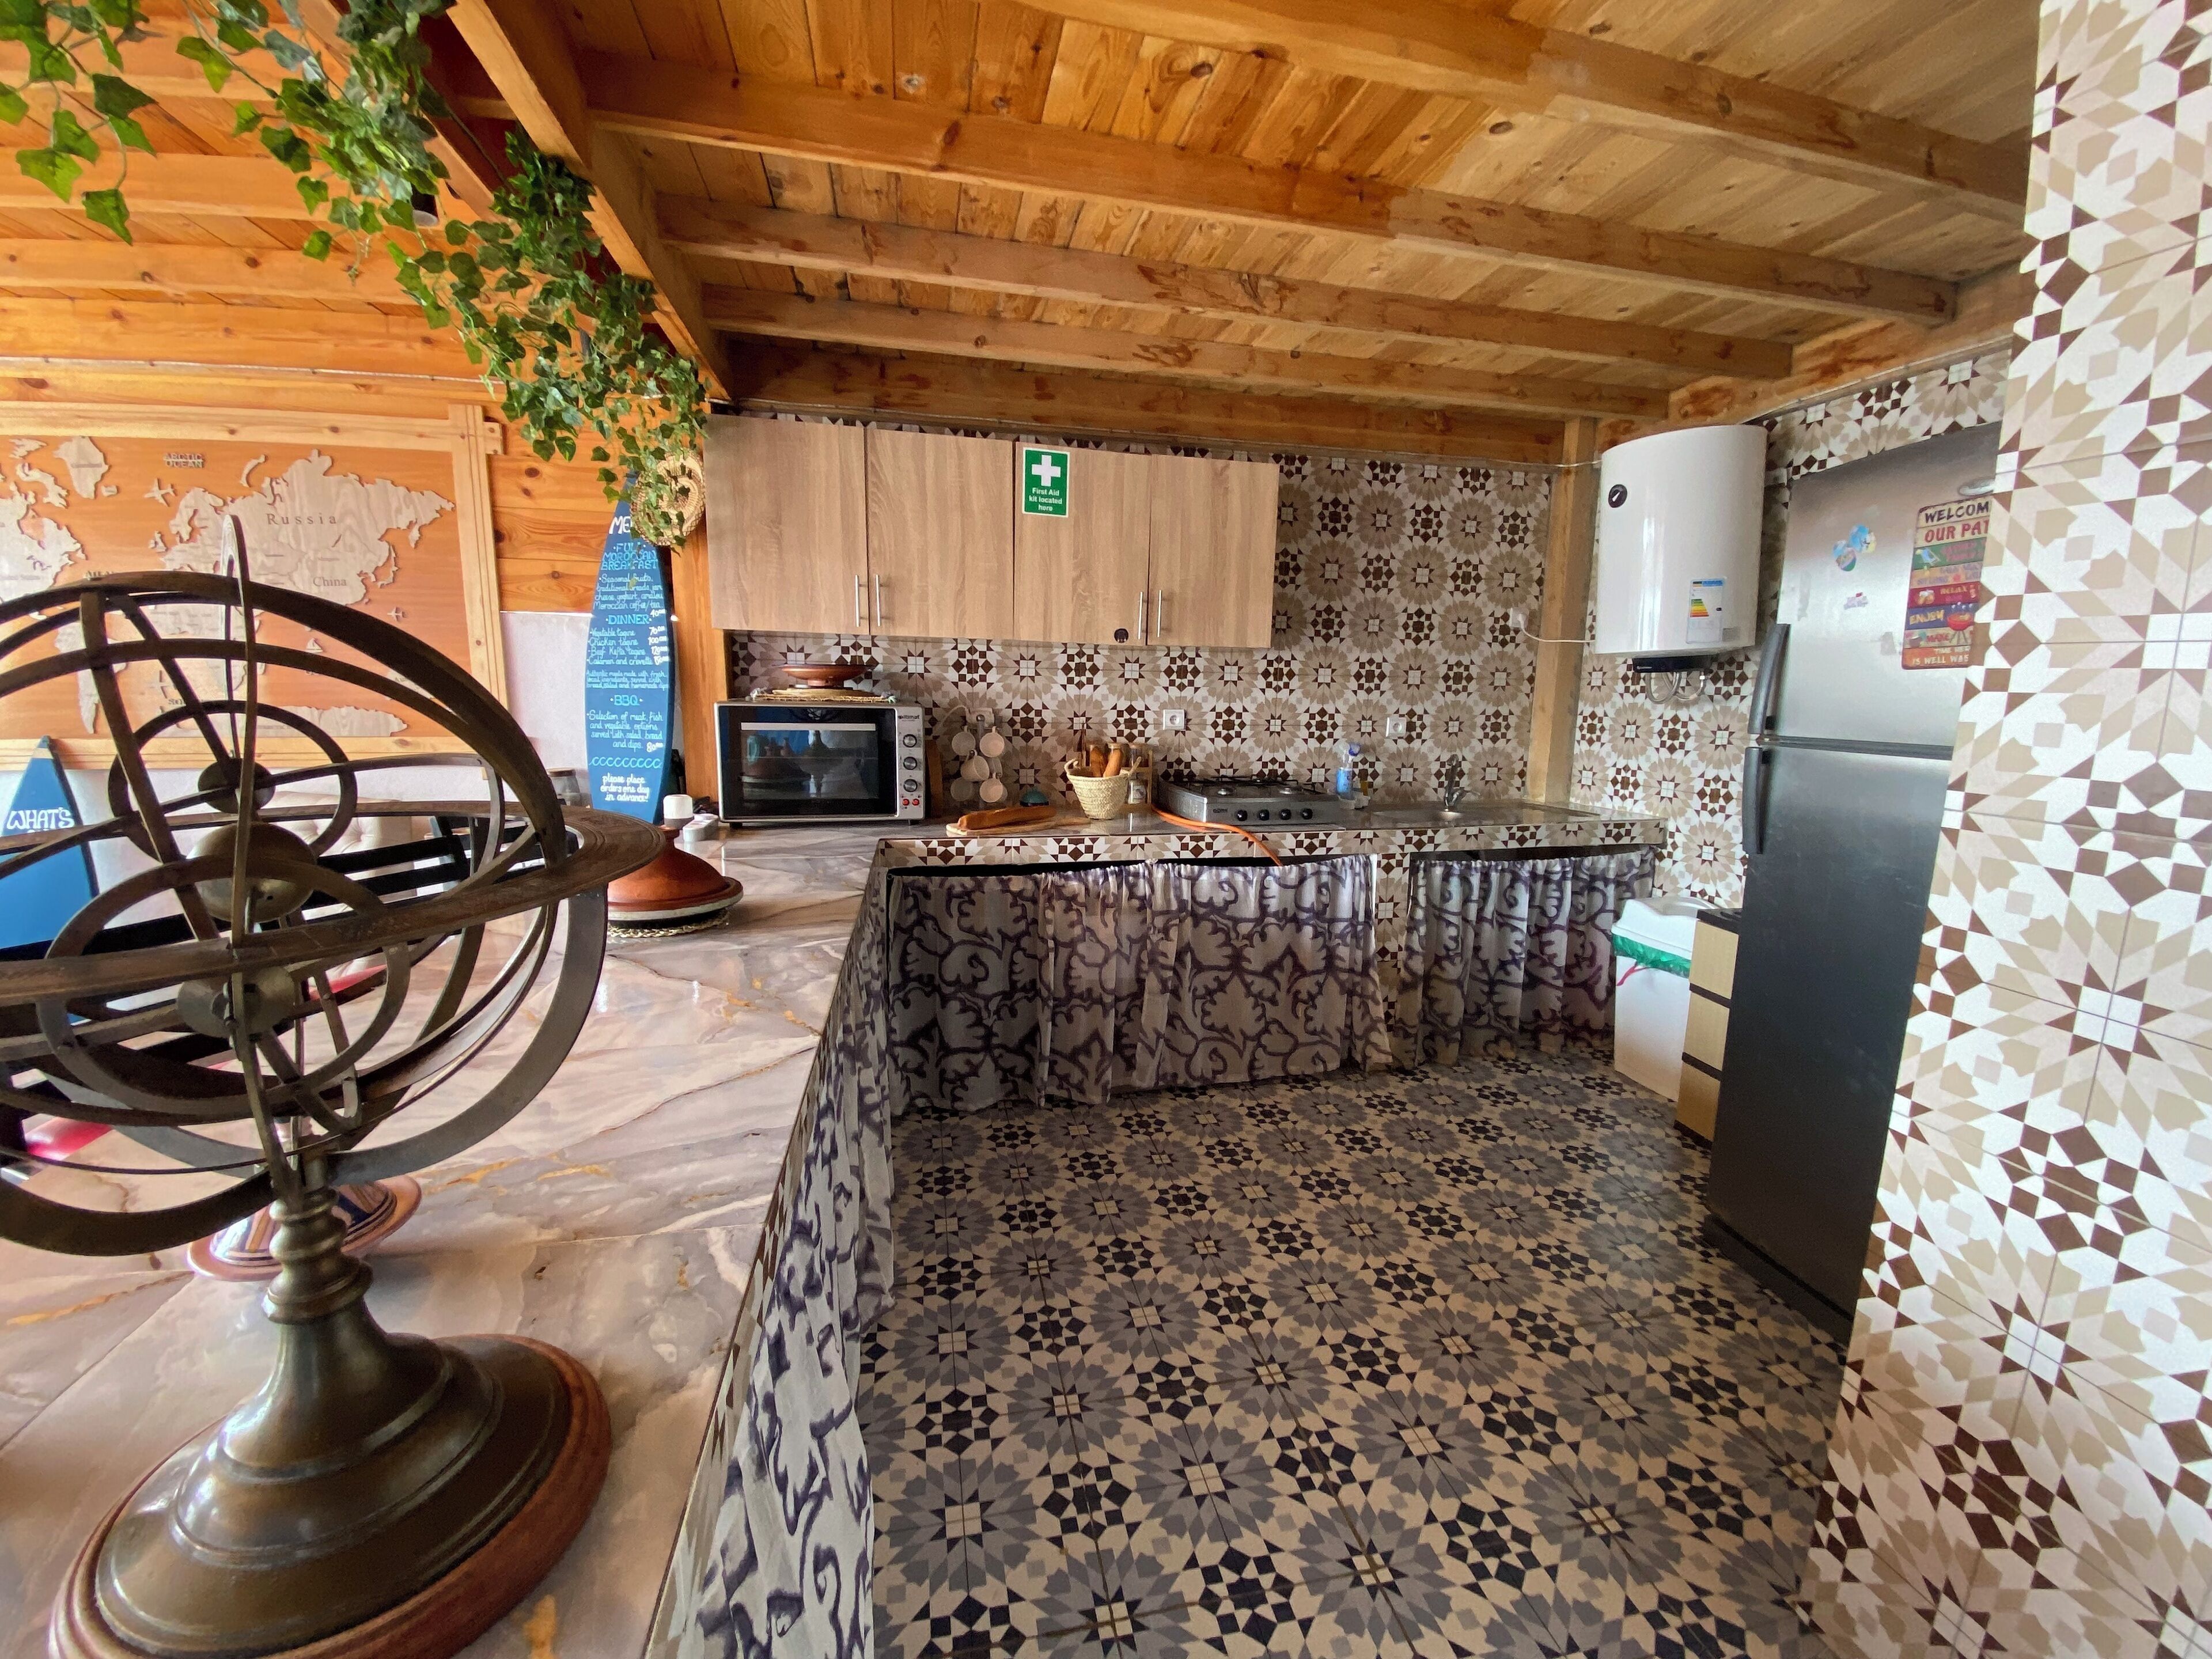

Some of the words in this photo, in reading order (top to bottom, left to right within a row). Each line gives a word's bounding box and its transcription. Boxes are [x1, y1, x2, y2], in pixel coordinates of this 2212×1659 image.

[163, 453, 204, 461] ARCTIC
[1925, 501, 1989, 524] WELCOM
[267, 513, 337, 525] Russia
[1925, 526, 1955, 543] OUR
[313, 577, 347, 586] China
[601, 573, 630, 583] Seasonal
[596, 582, 628, 592] traditional
[1940, 585, 1968, 594] RELAX
[593, 600, 628, 610] Moroccan
[608, 614, 649, 624] DINNER
[1909, 609, 1945, 625] ENJOY
[592, 627, 616, 638] Vegetable
[617, 627, 635, 640] tagine
[589, 637, 616, 646] Chicken
[618, 638, 639, 647] tagine
[591, 646, 606, 658] Beef
[628, 647, 646, 659] tagine
[615, 657, 628, 665] and
[1925, 656, 1946, 664] WELL
[649, 675, 662, 684] with
[650, 670, 667, 679] fresh
[614, 695, 640, 706] BBQ
[589, 709, 618, 721] Selection
[620, 711, 628, 721] of
[649, 711, 663, 724] fish
[589, 721, 603, 729] and
[604, 719, 631, 730] vegetable
[634, 721, 658, 732] options
[591, 730, 611, 738] served
[611, 729, 624, 739] with
[645, 730, 663, 740] bread
[612, 738, 627, 748] and
[602, 772, 625, 786] please
[626, 773, 646, 786] place
[600, 783, 622, 793] orders
[623, 785, 636, 793] one
[637, 783, 650, 799] day
[604, 792, 615, 801] in
[6, 806, 75, 830] WHAT'S
